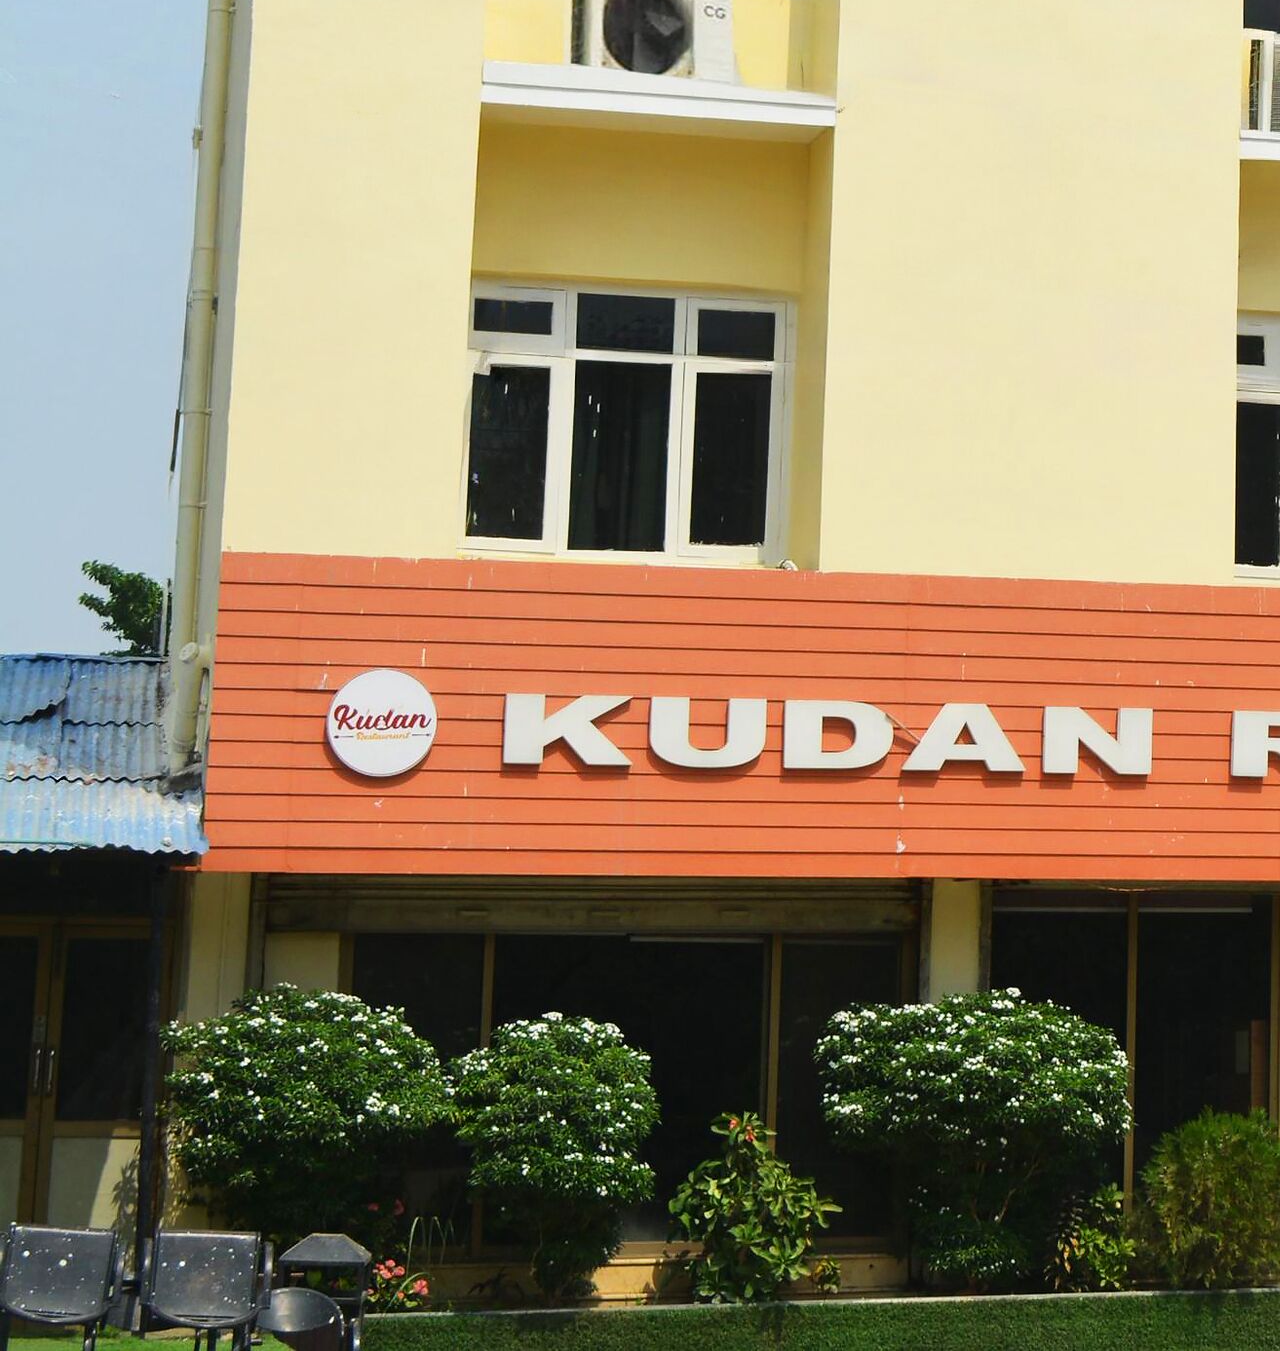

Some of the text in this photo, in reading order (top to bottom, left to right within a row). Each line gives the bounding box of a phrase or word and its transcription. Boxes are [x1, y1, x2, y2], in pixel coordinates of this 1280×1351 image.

[704, 5, 726, 20] CG
[334, 704, 432, 730] Kudan
[502, 692, 1153, 776] KUDAN
